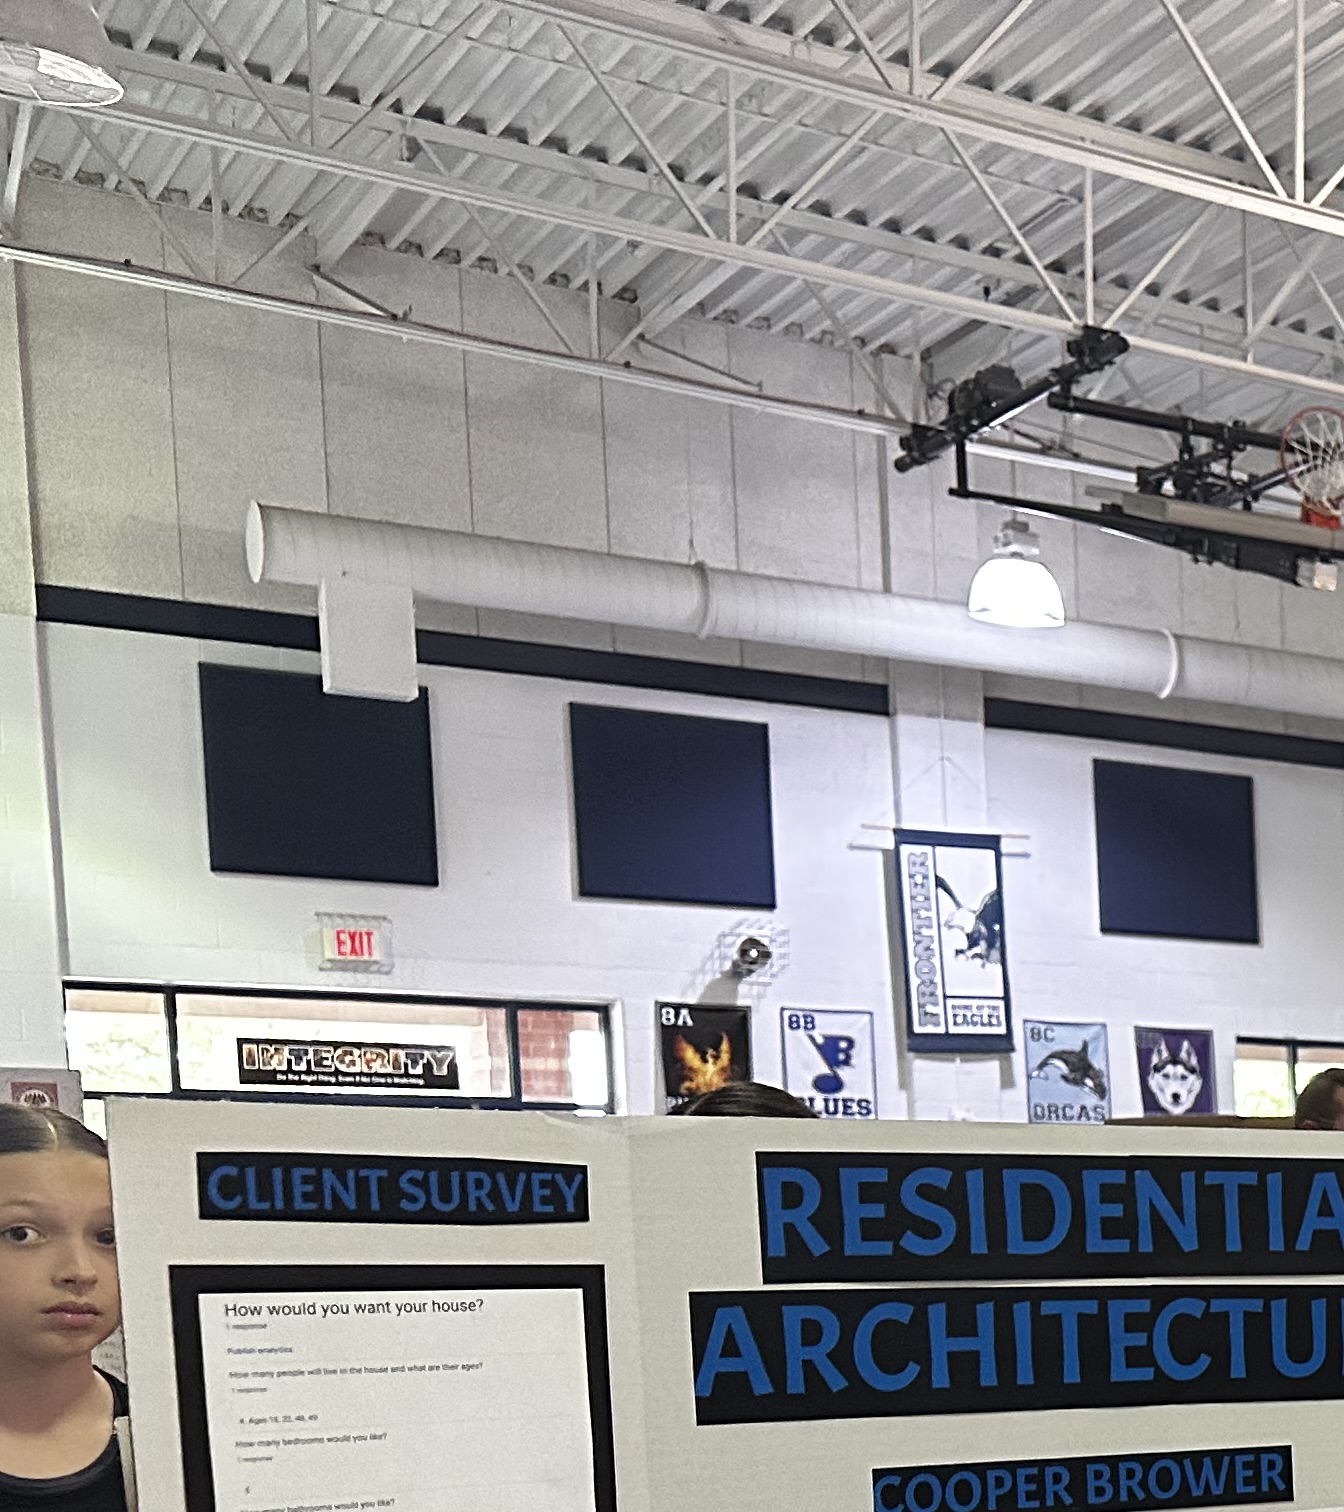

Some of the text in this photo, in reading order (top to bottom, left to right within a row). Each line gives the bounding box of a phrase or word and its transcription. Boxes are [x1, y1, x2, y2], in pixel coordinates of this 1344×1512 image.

[335, 929, 375, 958] EXIT
[661, 1007, 694, 1027] 8A
[788, 1014, 816, 1031] 8B
[952, 1013, 1002, 1028] EAGLES
[1029, 1027, 1055, 1043] 8C
[242, 1043, 455, 1076] INTEGRITY
[804, 1097, 872, 1116] LUES
[1033, 1103, 1105, 1121] ORCAS
[207, 1164, 584, 1214] CLIENT SURVEY
[225, 1299, 484, 1318] How would you want your house?
[1086, 1452, 1286, 1506] BROWER
